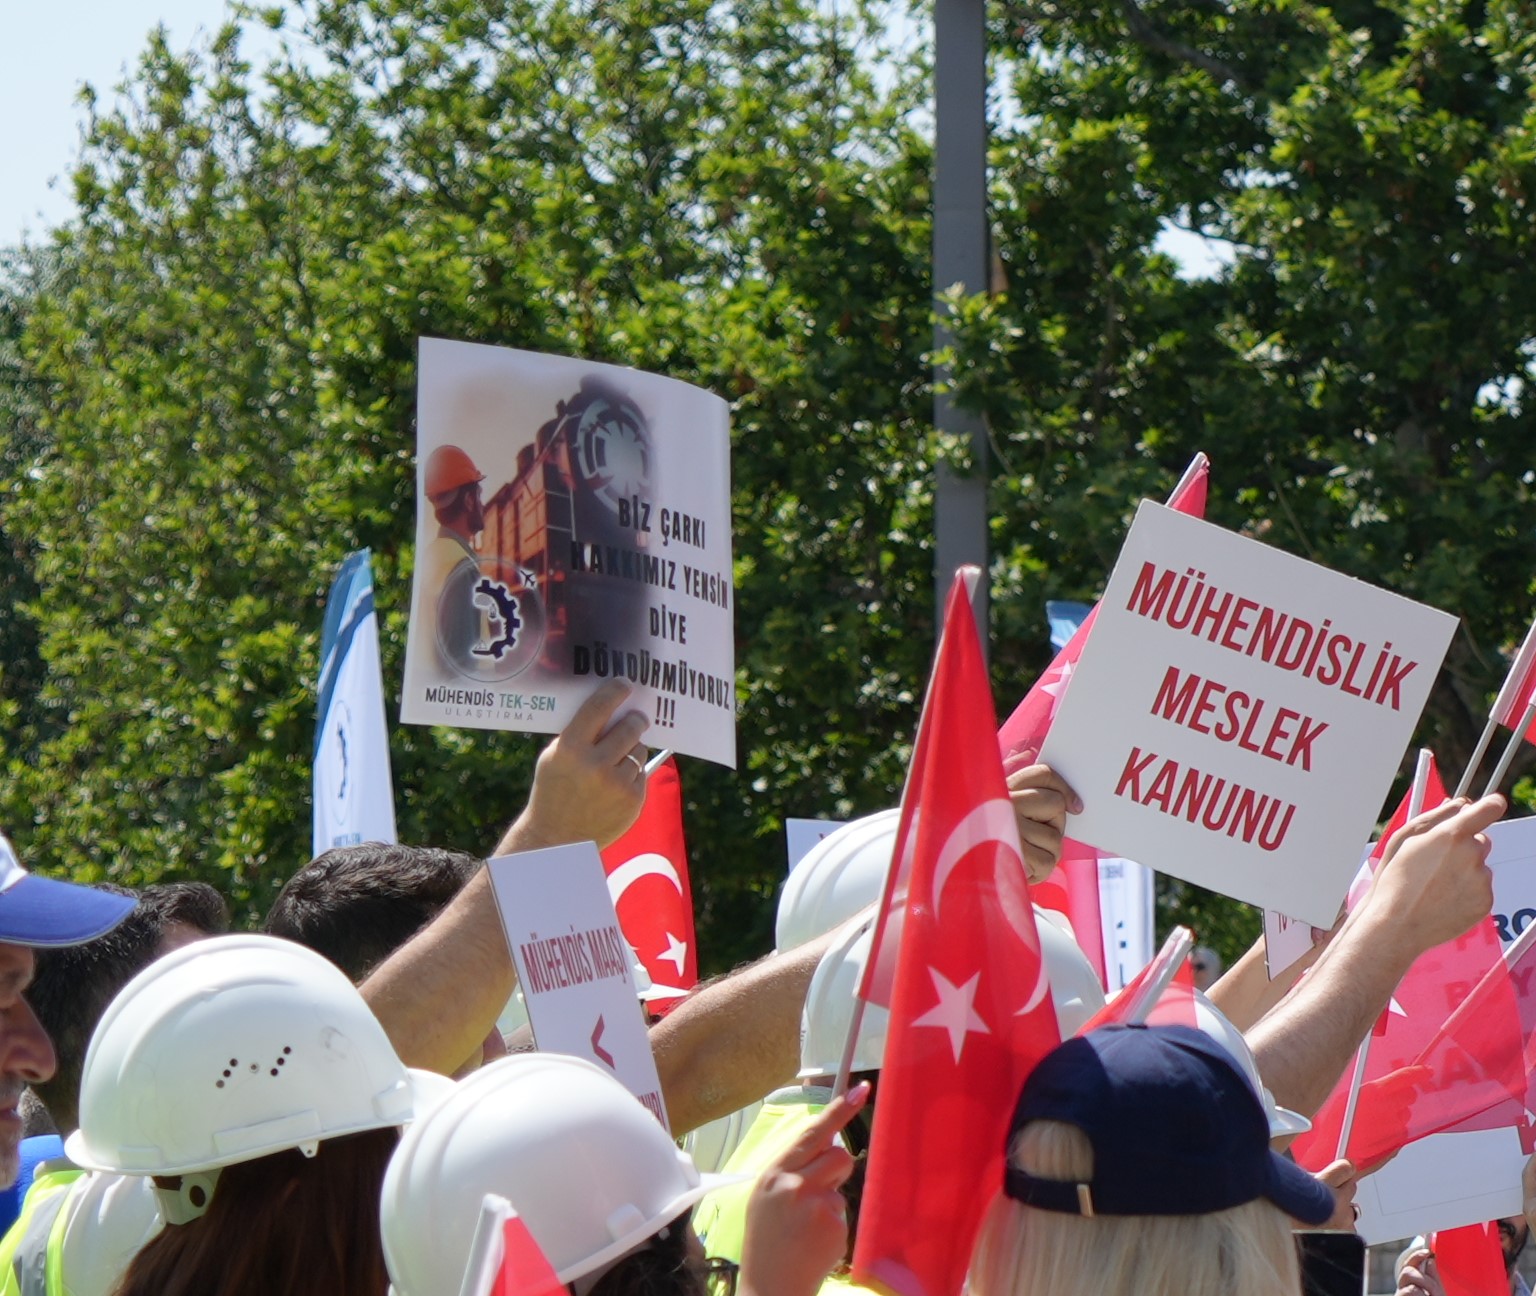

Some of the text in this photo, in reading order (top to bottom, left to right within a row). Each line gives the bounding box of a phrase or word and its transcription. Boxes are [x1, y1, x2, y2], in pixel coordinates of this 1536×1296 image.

[618, 495, 706, 549] BİZ ÇARKI
[571, 541, 729, 610] HAKKIMIZ YENSİN
[650, 604, 687, 645] DİYE
[1126, 560, 1419, 712] MÜHENDİSLİK
[425, 686, 556, 712] MÜHENDİS TEK-SEN
[573, 641, 730, 711] DÖNDÜRMÜYORUZ
[1150, 665, 1330, 773] MESLEK
[1113, 746, 1297, 852] KANUNU
[520, 925, 629, 995] MÜHENDİS MAAŞI
